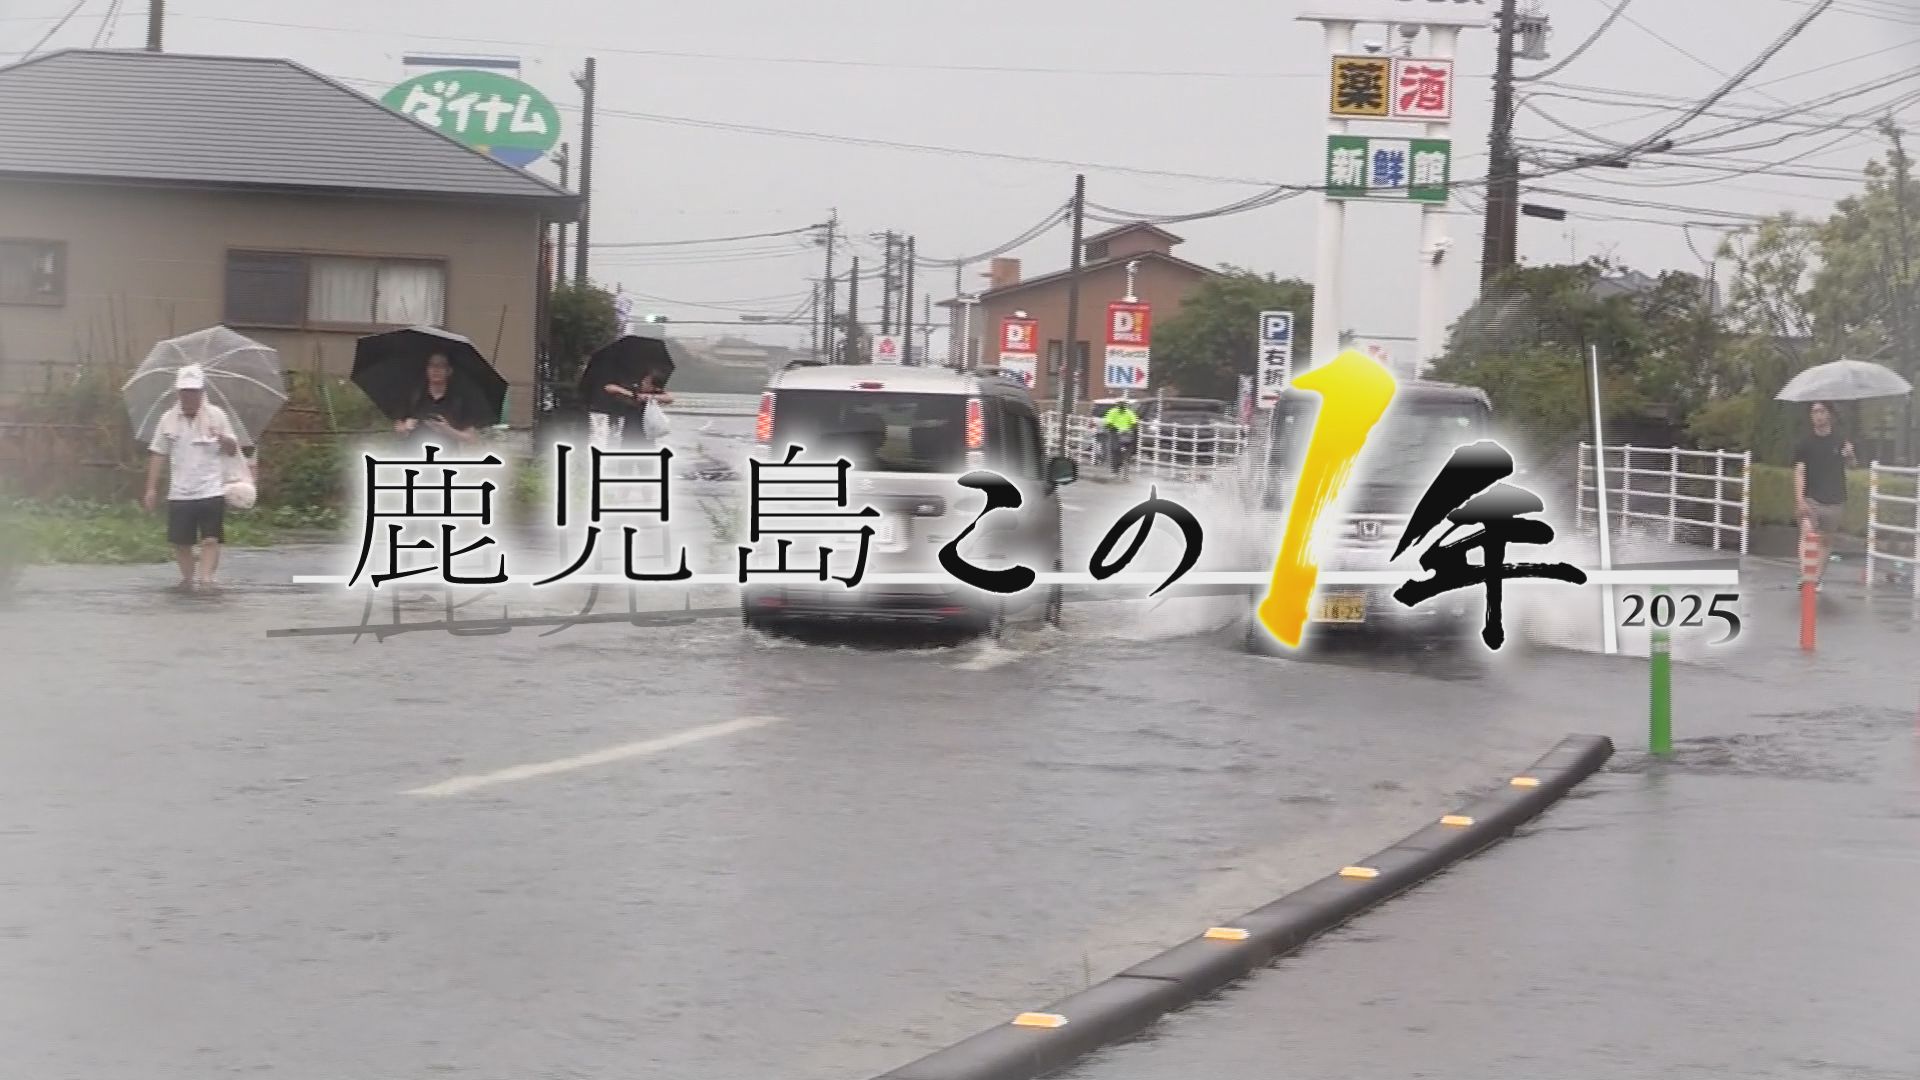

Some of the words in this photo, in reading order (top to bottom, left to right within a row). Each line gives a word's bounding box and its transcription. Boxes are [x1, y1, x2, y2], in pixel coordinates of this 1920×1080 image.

[1336, 62, 1385, 109] 薬
[1399, 65, 1447, 111] 酒
[401, 80, 548, 134] ダイナム
[1330, 148, 1446, 187] 新鮮館
[1267, 317, 1287, 338] P
[1108, 365, 1133, 383] IN
[1263, 350, 1286, 385] 右折
